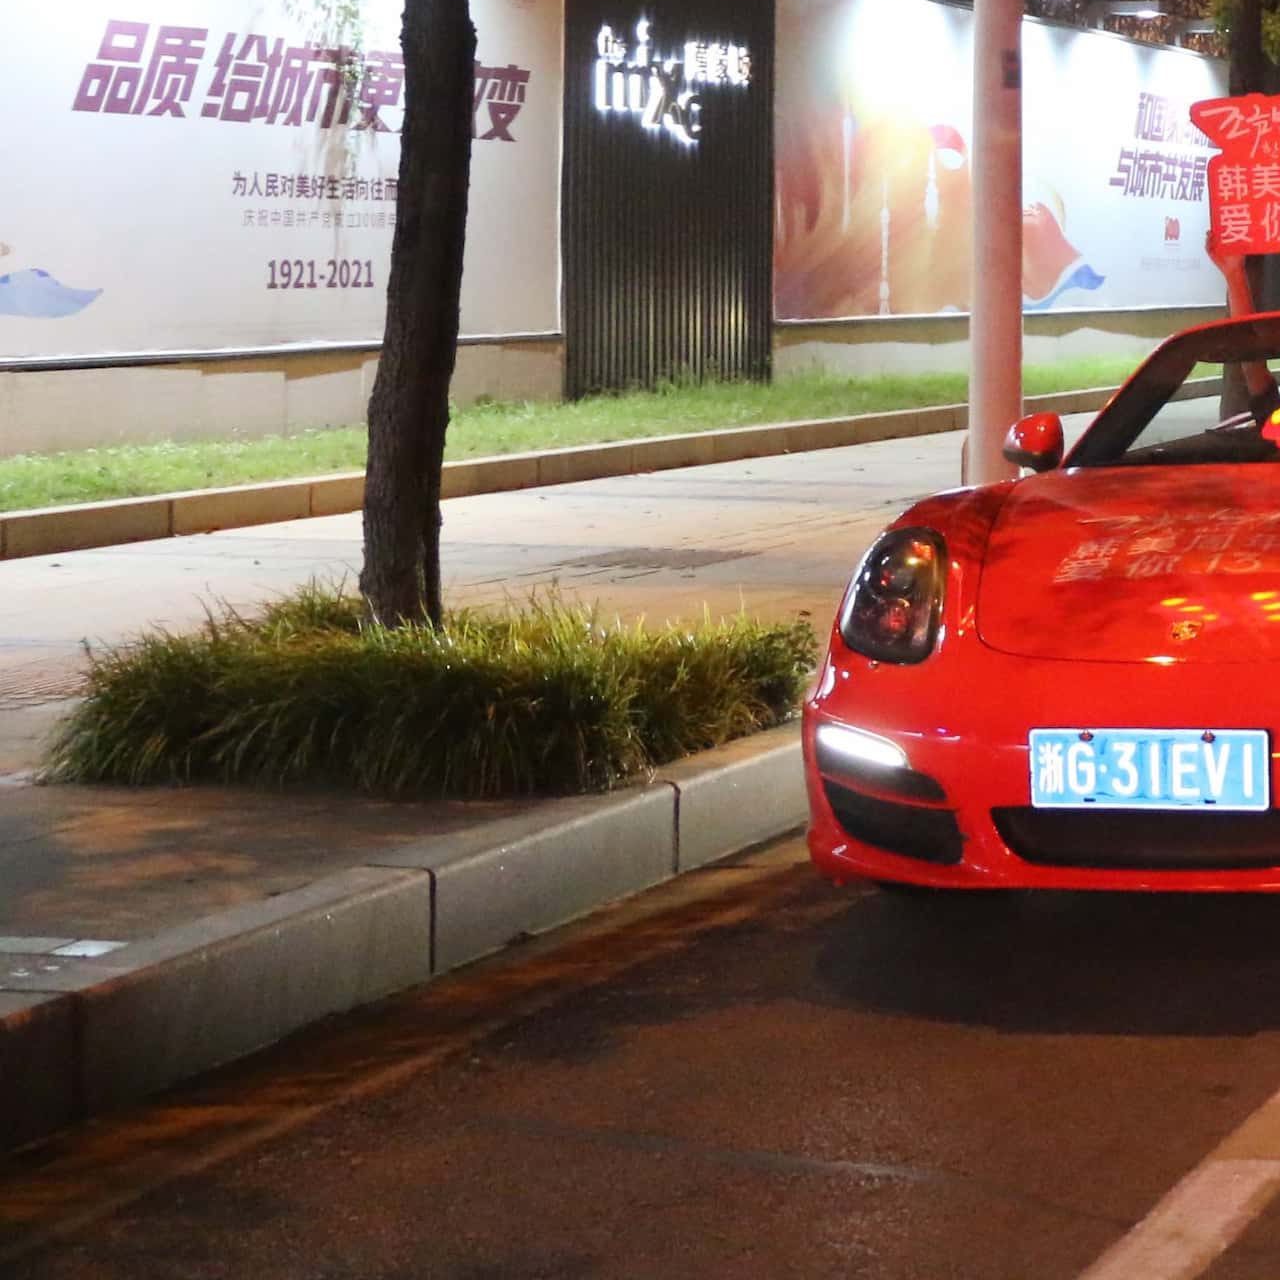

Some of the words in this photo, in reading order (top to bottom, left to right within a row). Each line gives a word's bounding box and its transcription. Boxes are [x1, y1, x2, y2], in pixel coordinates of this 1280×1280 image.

[71, 19, 531, 144] 品质给城市更变
[267, 259, 375, 289] 1921-2021
